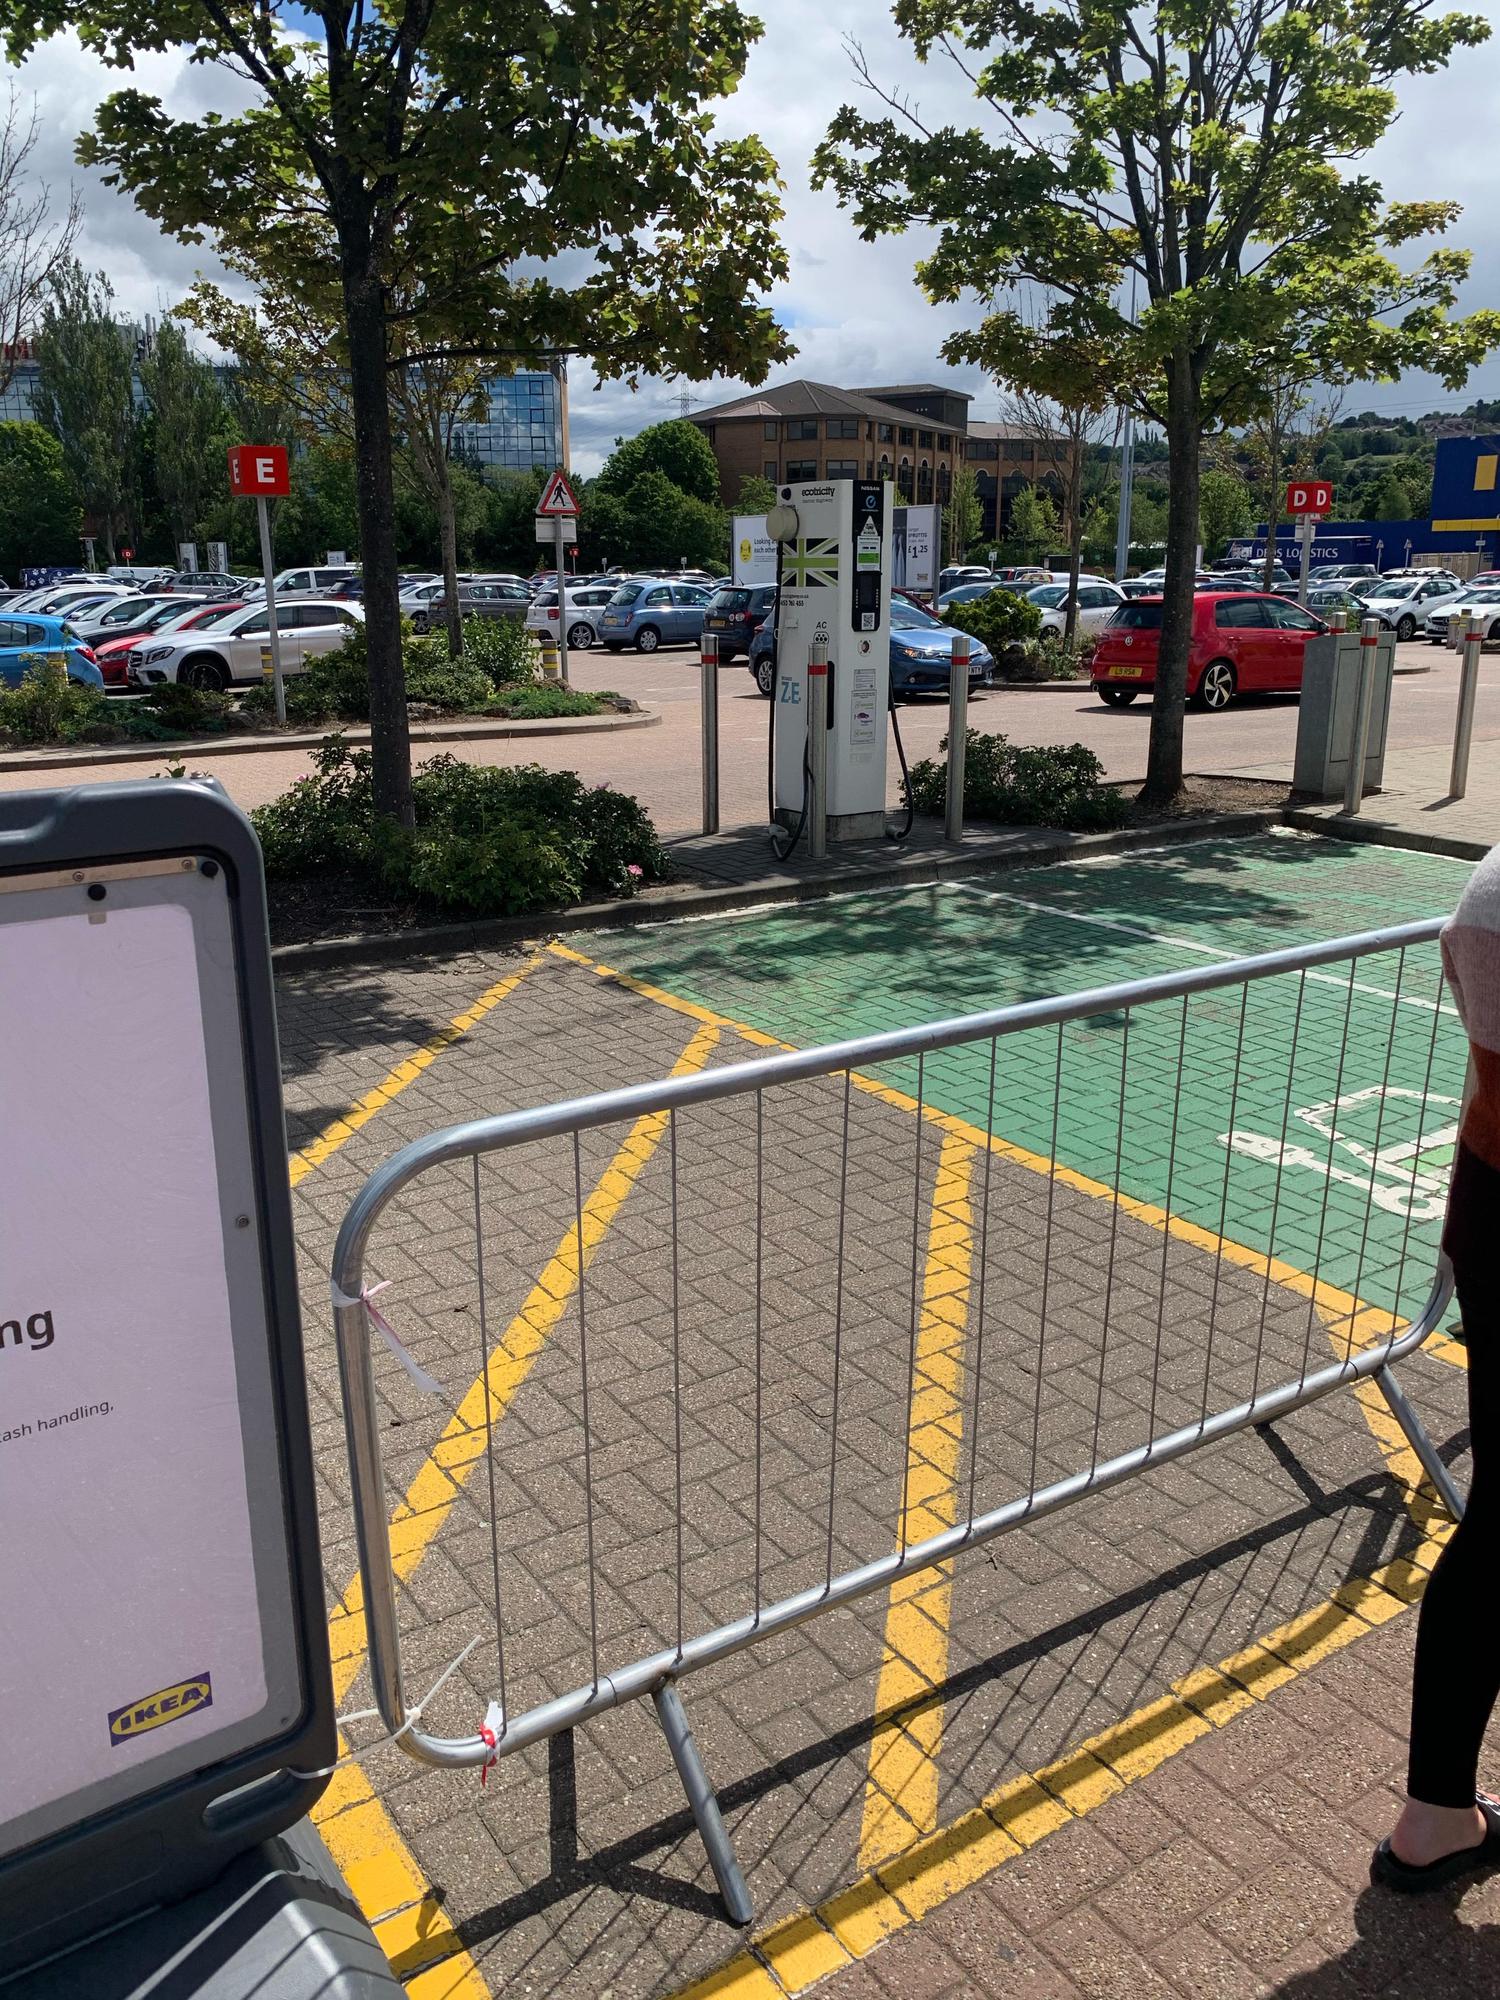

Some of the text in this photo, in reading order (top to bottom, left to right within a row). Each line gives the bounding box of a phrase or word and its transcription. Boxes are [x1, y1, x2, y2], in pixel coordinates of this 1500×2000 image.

[233, 459, 240, 484] E
[256, 458, 275, 483] E
[802, 486, 836, 497] ecotricity
[1294, 490, 1307, 507] D
[1316, 490, 1327, 506] D
[908, 545, 928, 559] £1.25
[1286, 548, 1339, 558] LOSTICS
[816, 621, 827, 629] AC
[37, 1401, 114, 1432] handling,
[119, 1685, 206, 1732] IKEA
